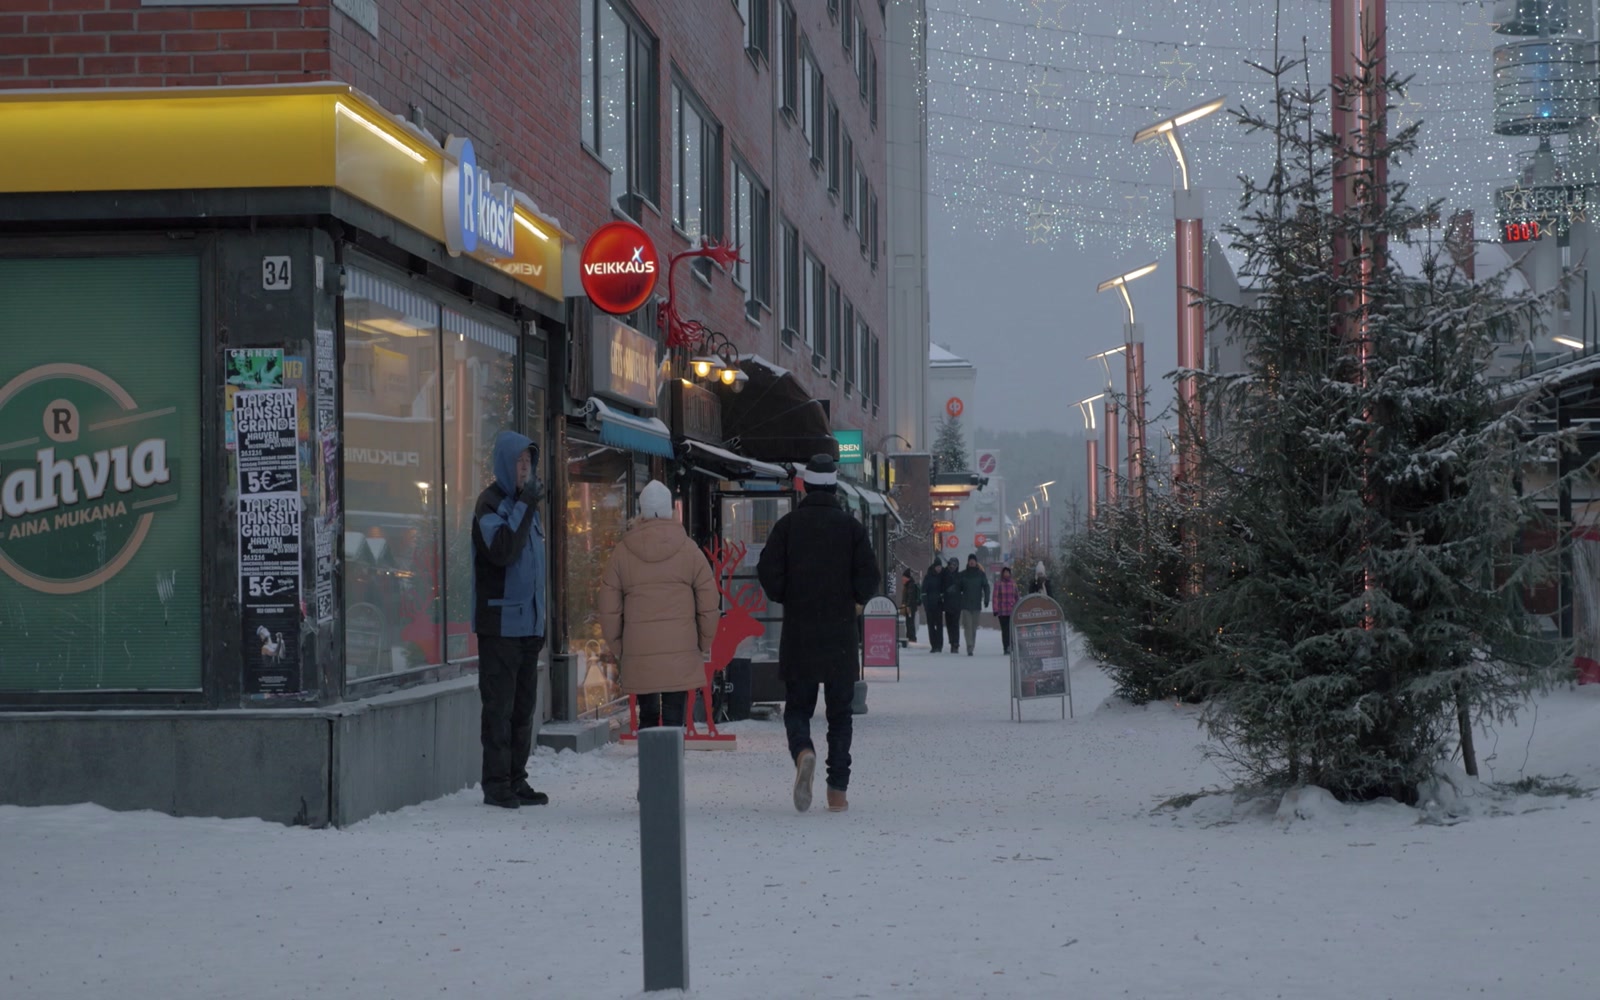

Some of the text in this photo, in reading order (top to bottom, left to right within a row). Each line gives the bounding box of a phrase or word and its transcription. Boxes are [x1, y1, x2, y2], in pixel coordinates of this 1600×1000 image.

[463, 162, 514, 255] R kioski
[265, 260, 289, 286] 34
[584, 260, 655, 276] VEIKKAUS
[230, 348, 280, 359] GRANDE
[240, 392, 295, 408] TAPSAN
[51, 408, 73, 434] R
[236, 405, 293, 421] TANSSIT
[238, 417, 297, 433] GRANDE
[838, 443, 860, 452] SSEN
[0, 437, 170, 518] ahvia
[247, 470, 273, 494] 5€
[244, 498, 299, 513] TAPSAN
[9, 500, 128, 541] AINA MUKANA
[241, 511, 297, 525] TANSSIT
[241, 523, 299, 537] GRANDE
[248, 576, 275, 597] 5€
